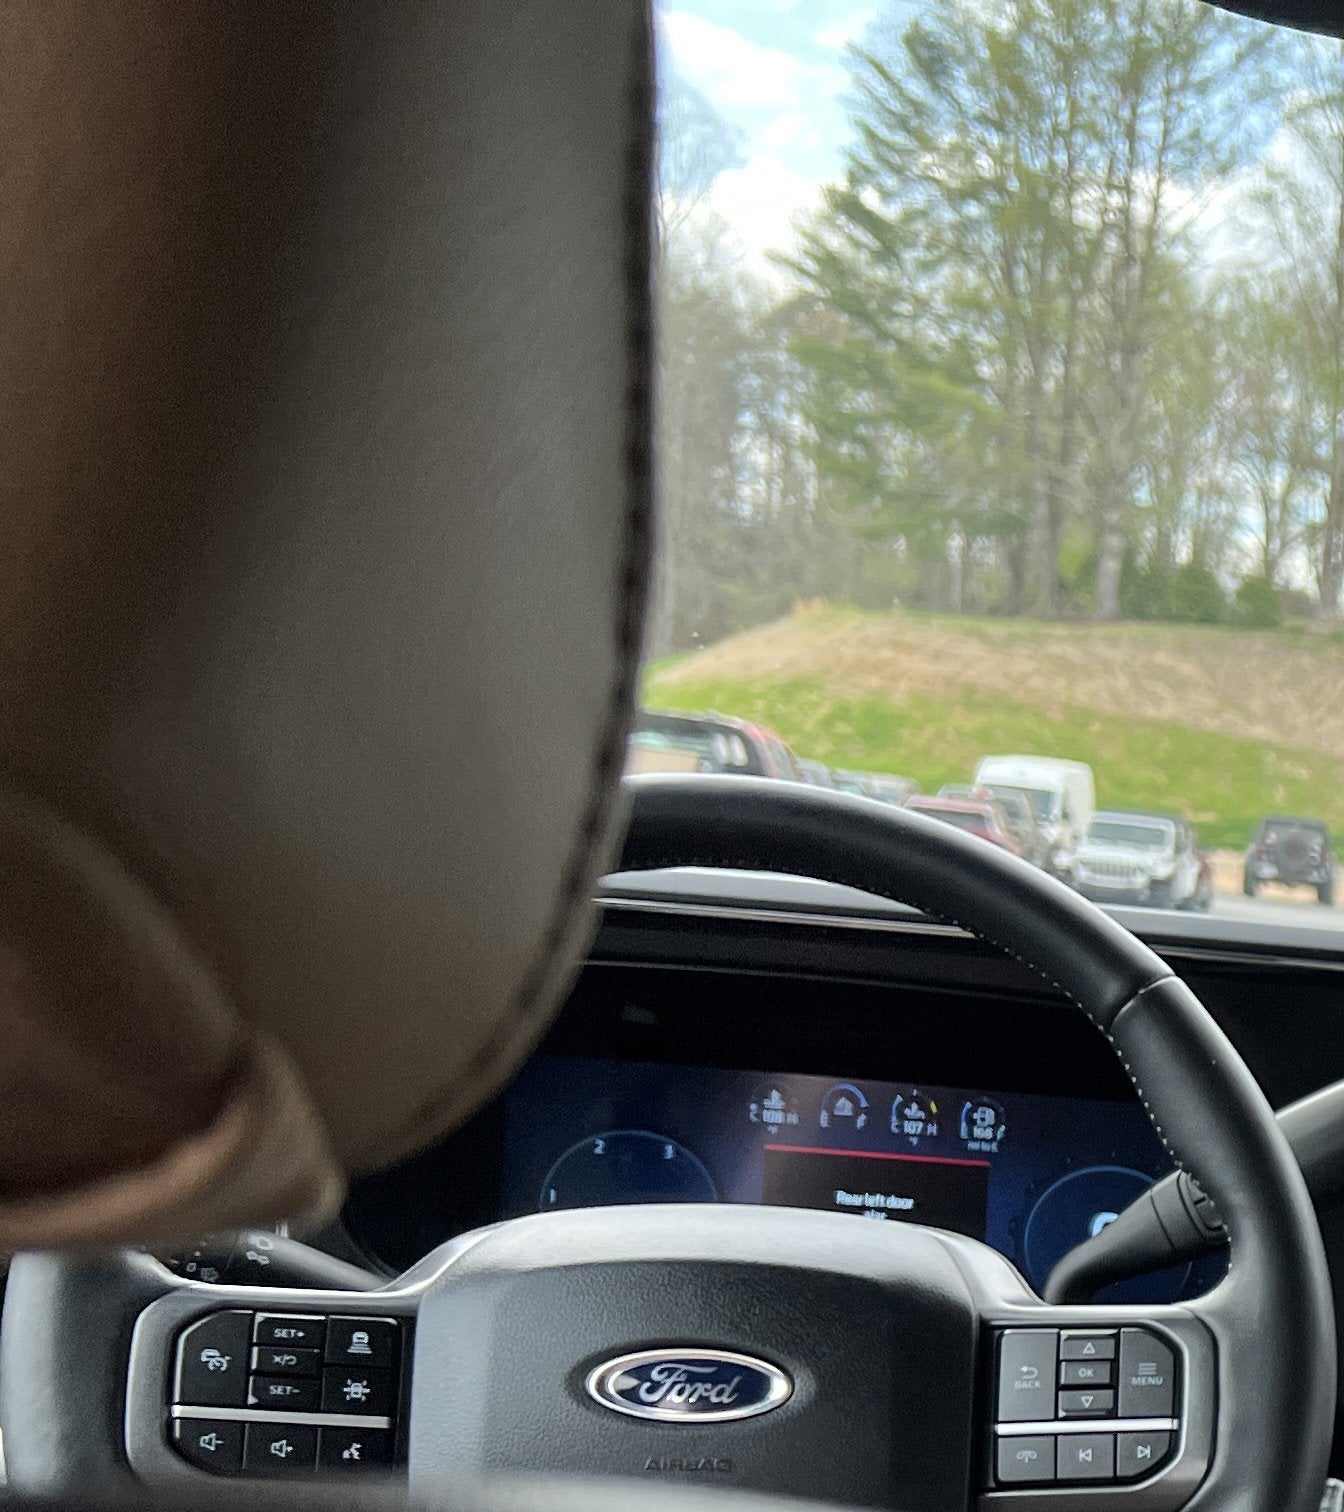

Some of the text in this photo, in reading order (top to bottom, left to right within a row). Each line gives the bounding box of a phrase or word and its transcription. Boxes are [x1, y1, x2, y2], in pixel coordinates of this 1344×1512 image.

[593, 1137, 606, 1155] 2
[1078, 1367, 1094, 1378] OK
[638, 1363, 743, 1404] Ford
[1013, 1379, 1042, 1389] BACK
[1130, 1375, 1164, 1386] MENU
